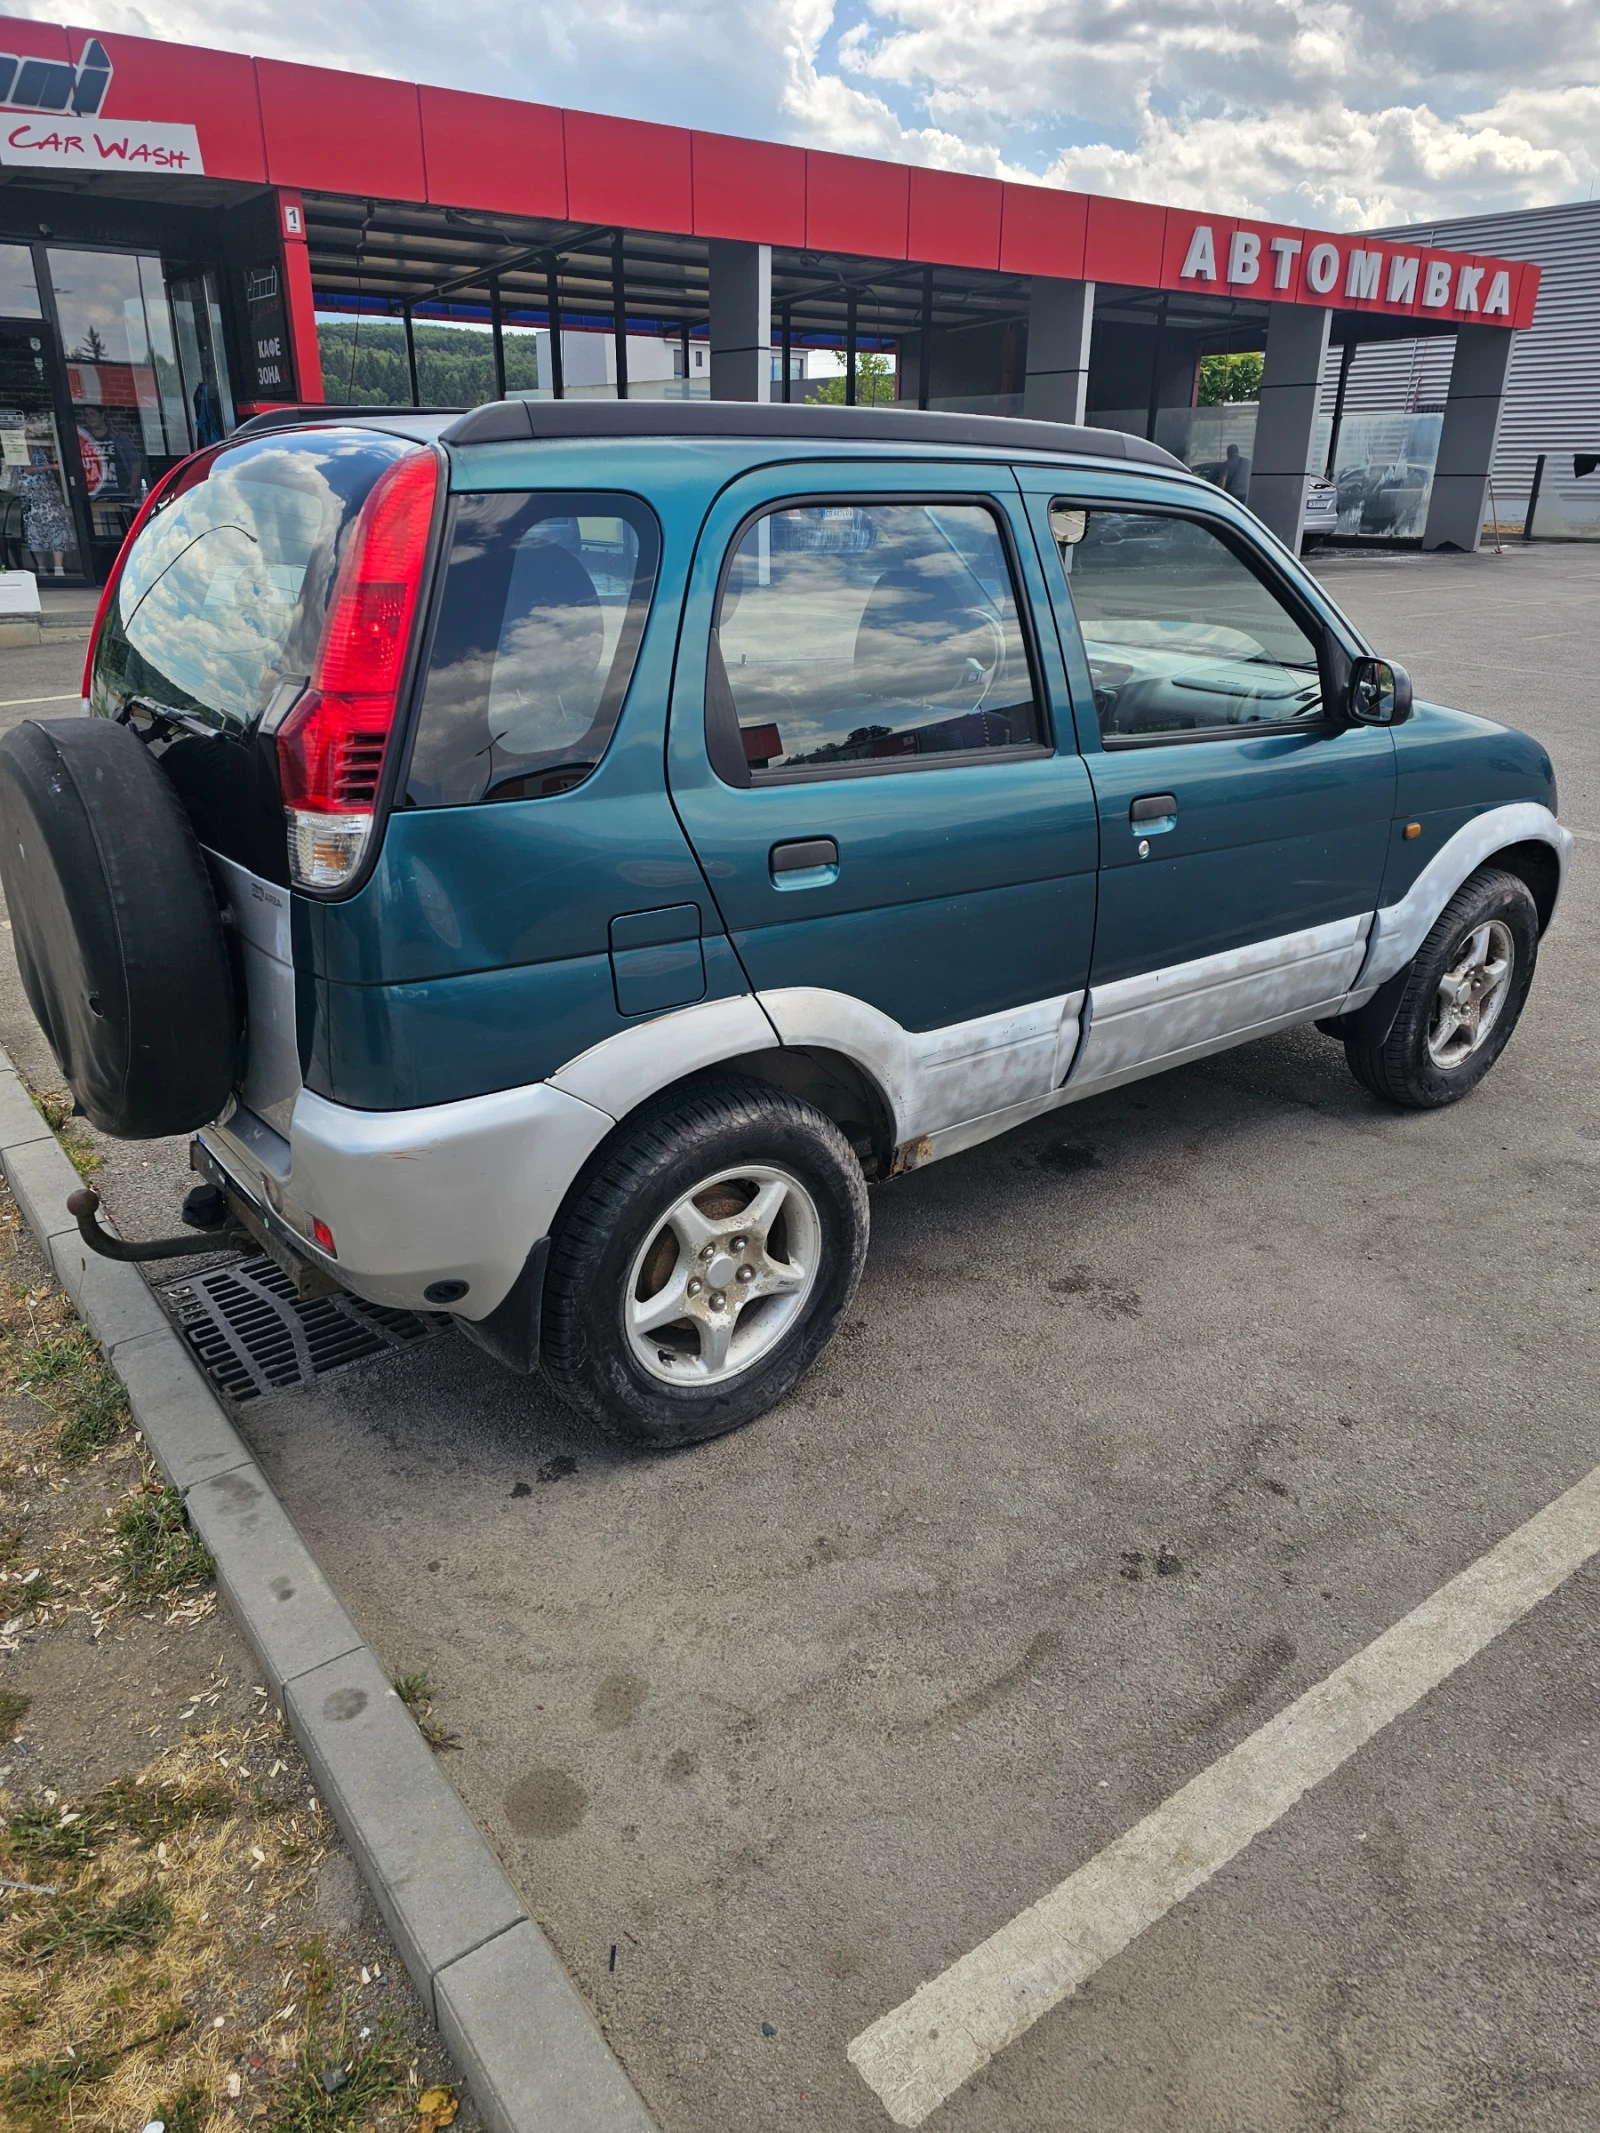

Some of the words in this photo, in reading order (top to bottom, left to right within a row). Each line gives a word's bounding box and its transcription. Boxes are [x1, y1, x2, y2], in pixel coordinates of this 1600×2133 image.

[8, 125, 85, 153] CAR
[93, 133, 191, 169] WASH
[289, 210, 297, 224] 1
[1180, 226, 1510, 316] АВТОМИВКА
[257, 337, 282, 359] КАФЕ
[257, 365, 281, 385] ЗОНА
